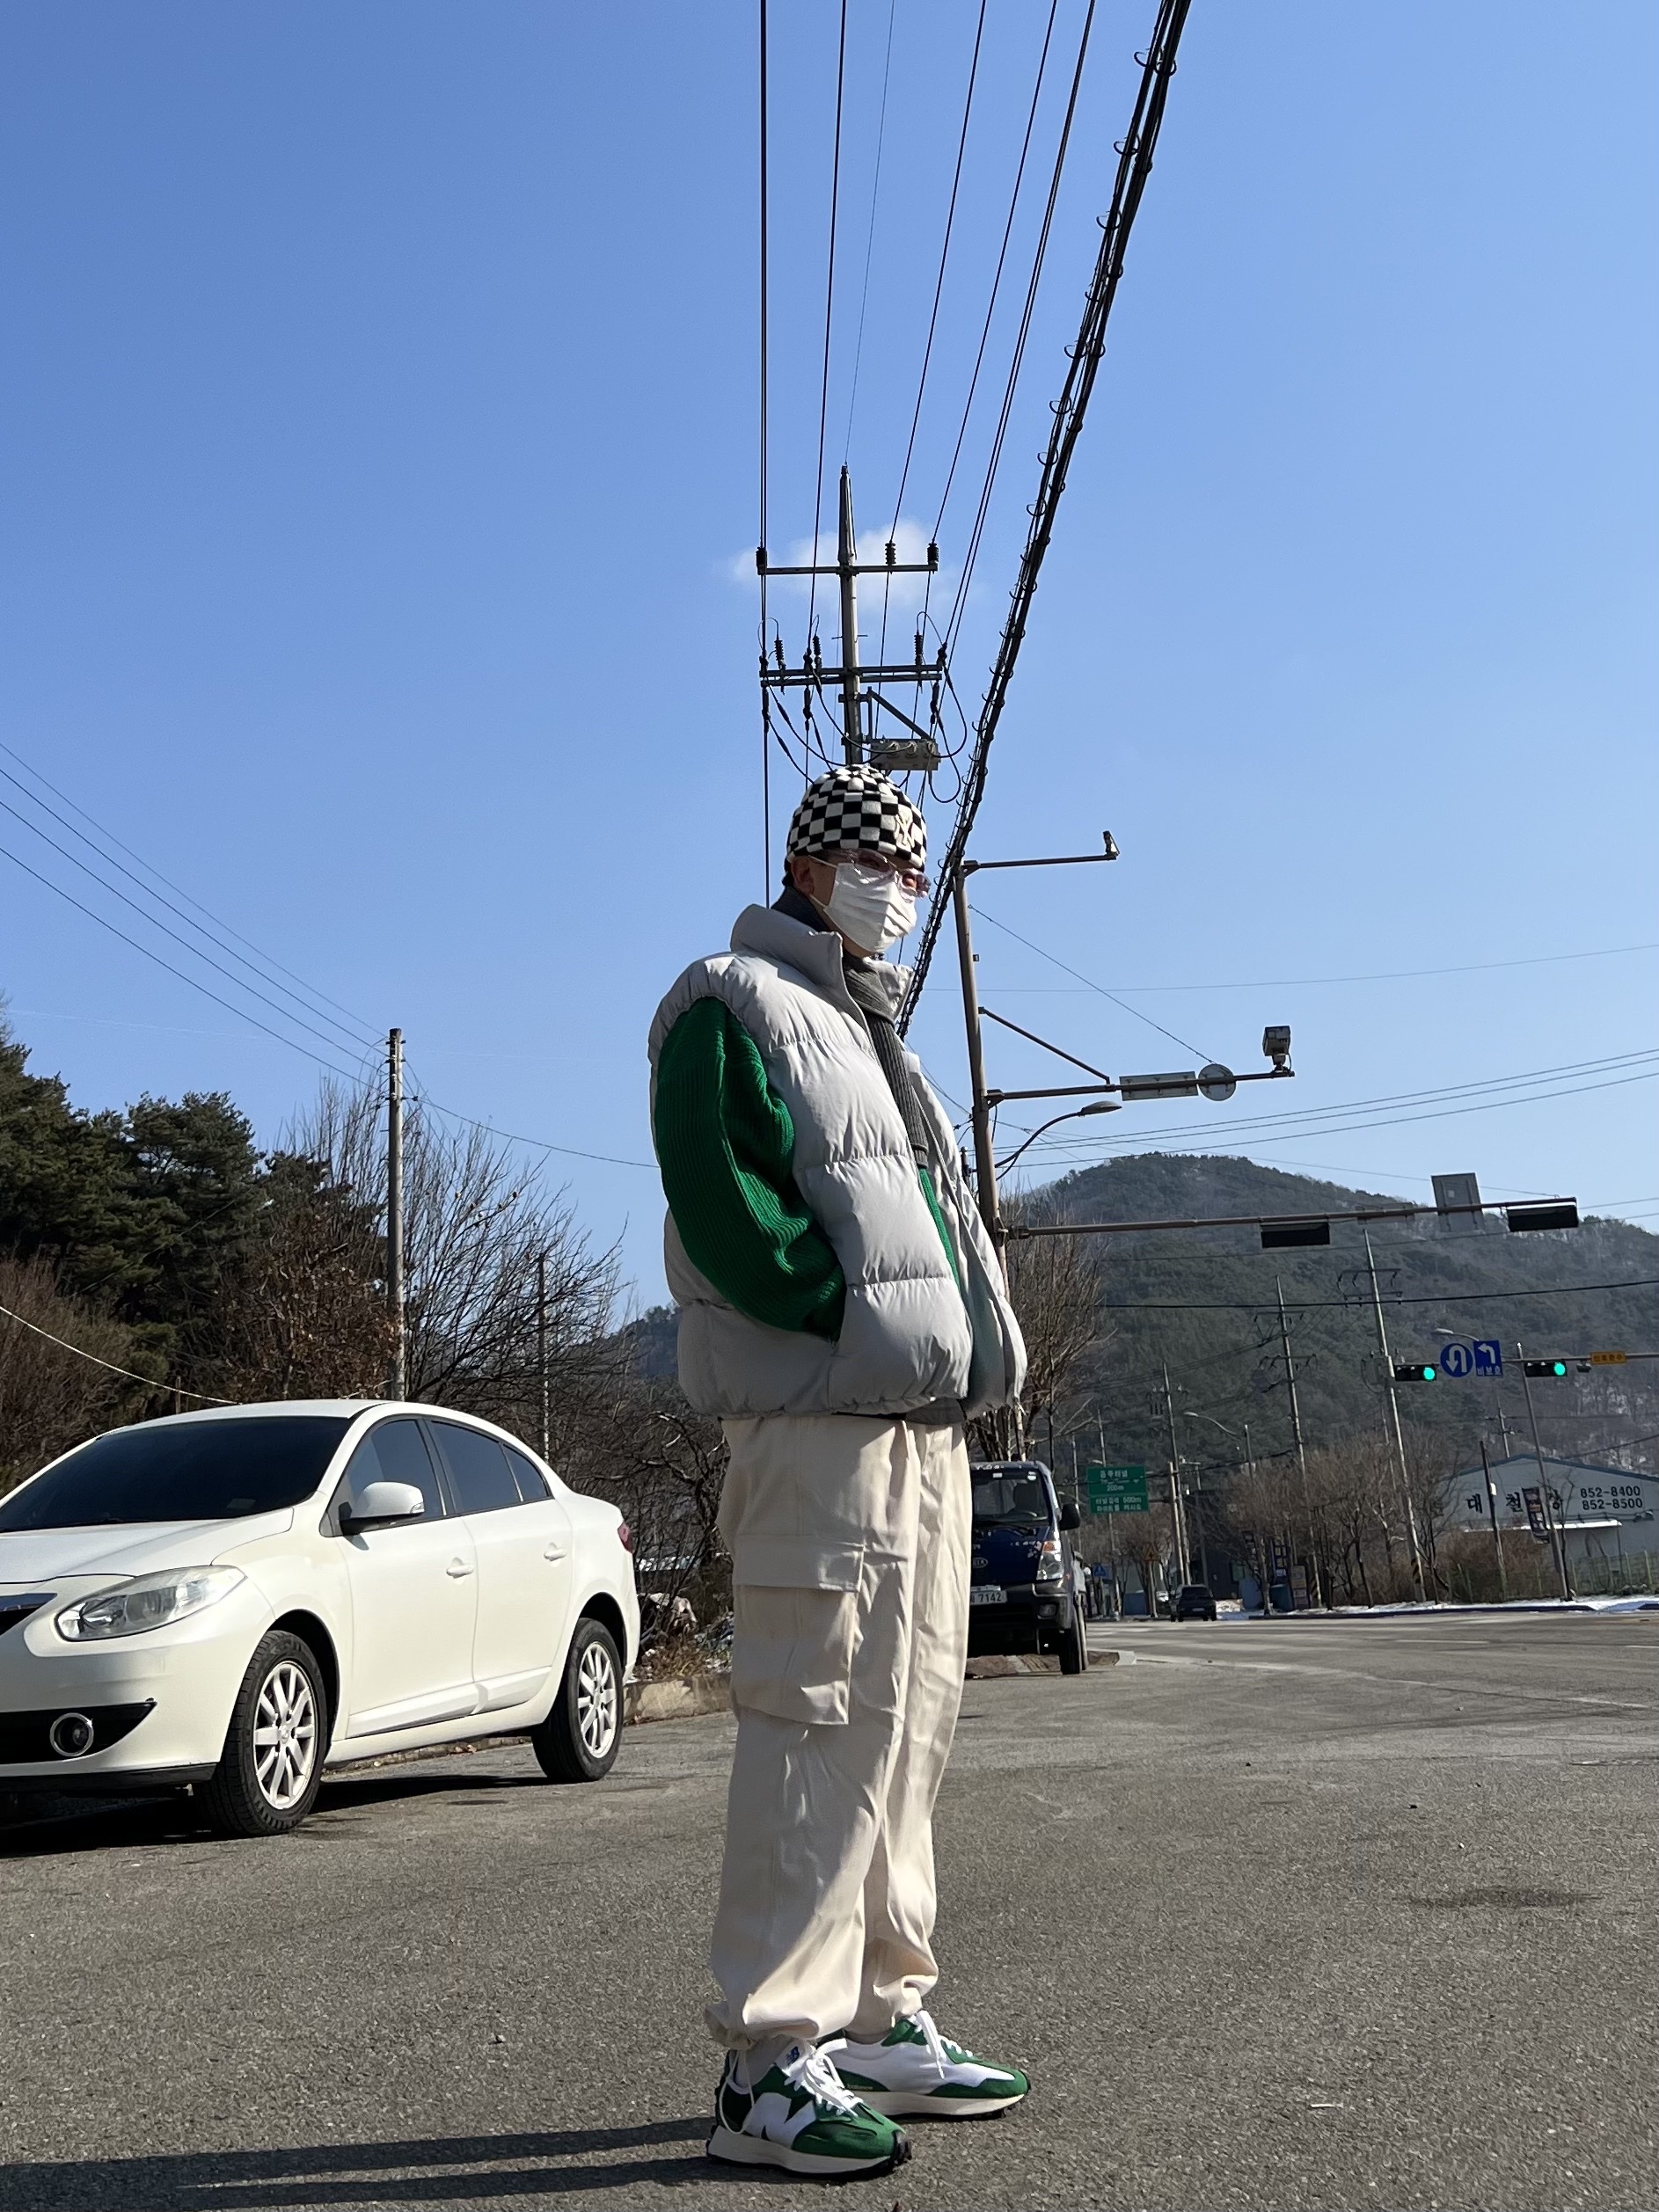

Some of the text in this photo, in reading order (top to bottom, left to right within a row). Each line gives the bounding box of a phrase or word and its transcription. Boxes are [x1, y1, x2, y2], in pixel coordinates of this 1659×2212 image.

[1477, 1365, 1502, 1376] 비보호
[1580, 1486, 1641, 1498] 852-8400
[1582, 1498, 1643, 1510] 852-8500
[978, 1592, 1002, 1602] 7142
